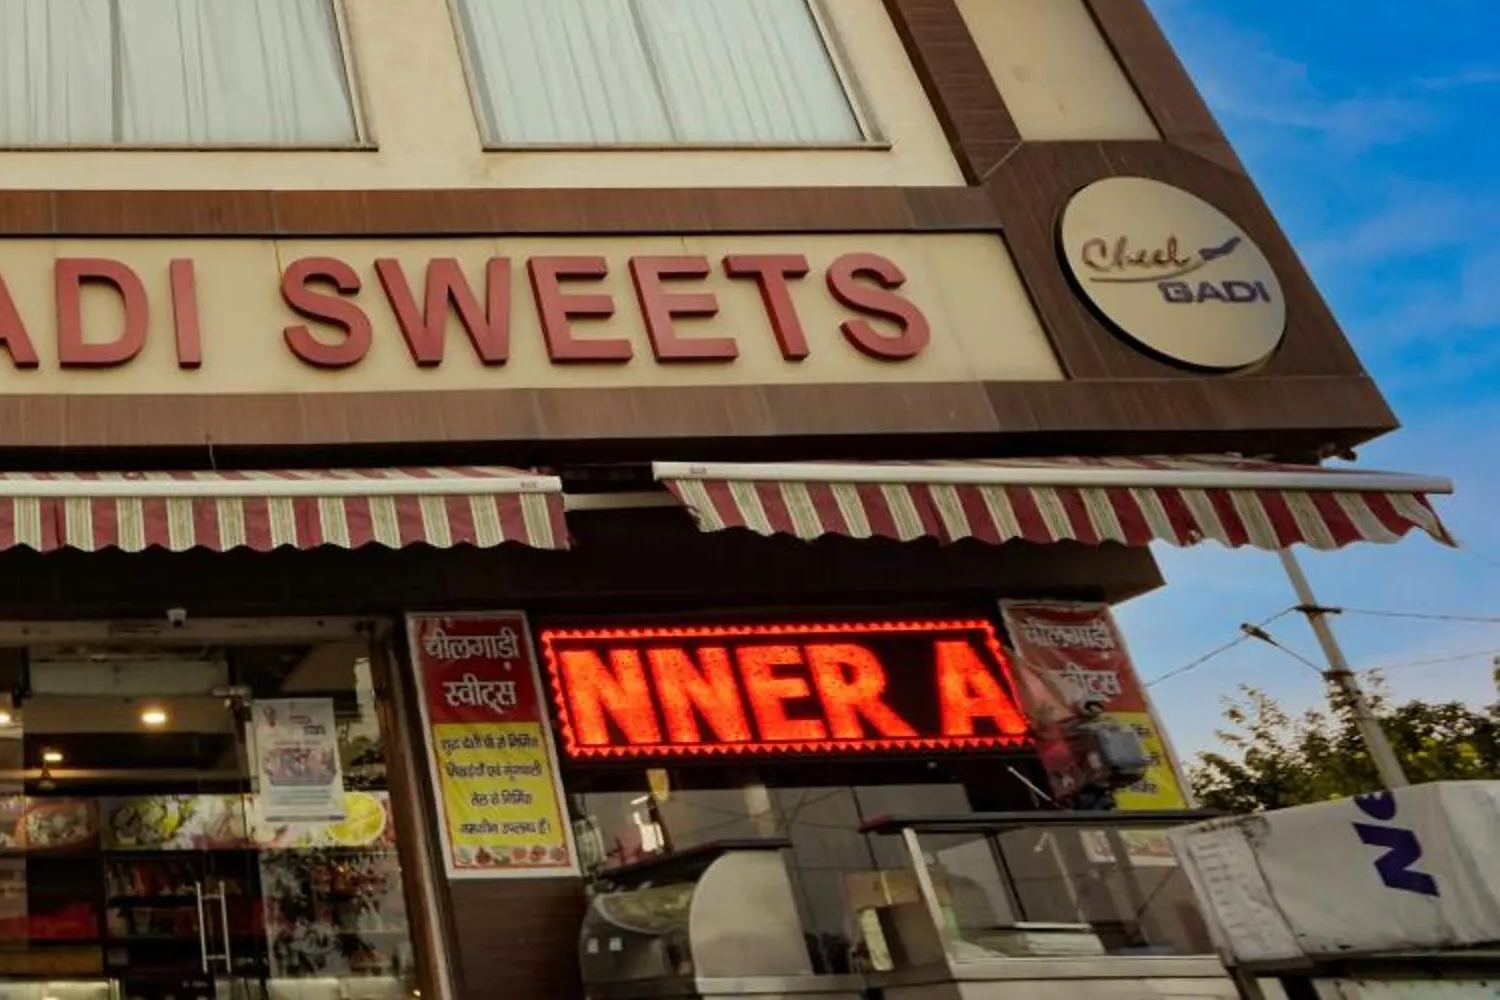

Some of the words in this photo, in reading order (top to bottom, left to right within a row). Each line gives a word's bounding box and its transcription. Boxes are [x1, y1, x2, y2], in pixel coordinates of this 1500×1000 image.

[279, 252, 931, 367] SWEETS
[1158, 280, 1272, 303] GADI
[558, 642, 919, 747] NNER
[933, 638, 1029, 737] A
